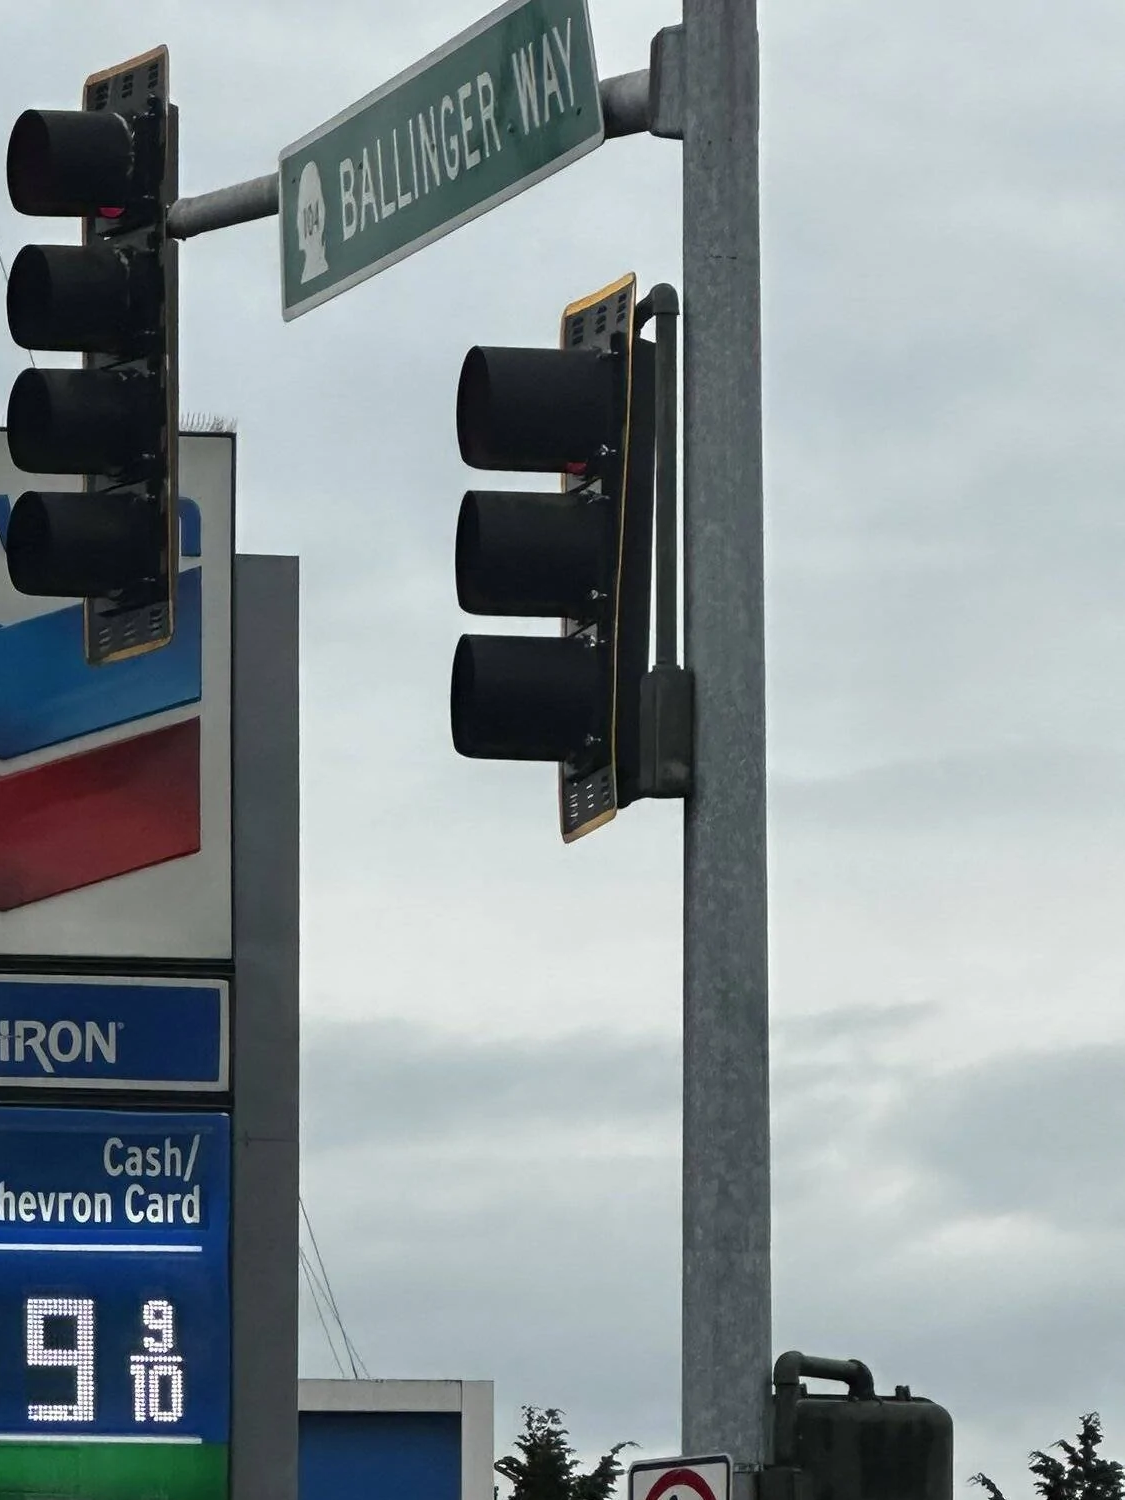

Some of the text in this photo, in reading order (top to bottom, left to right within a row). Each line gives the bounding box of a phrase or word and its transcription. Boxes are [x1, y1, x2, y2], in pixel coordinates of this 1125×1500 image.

[339, 17, 575, 242] BALLINGER WAY
[303, 199, 320, 240] 104
[102, 1134, 201, 1183] Cash/
[123, 1184, 201, 1225] Card
